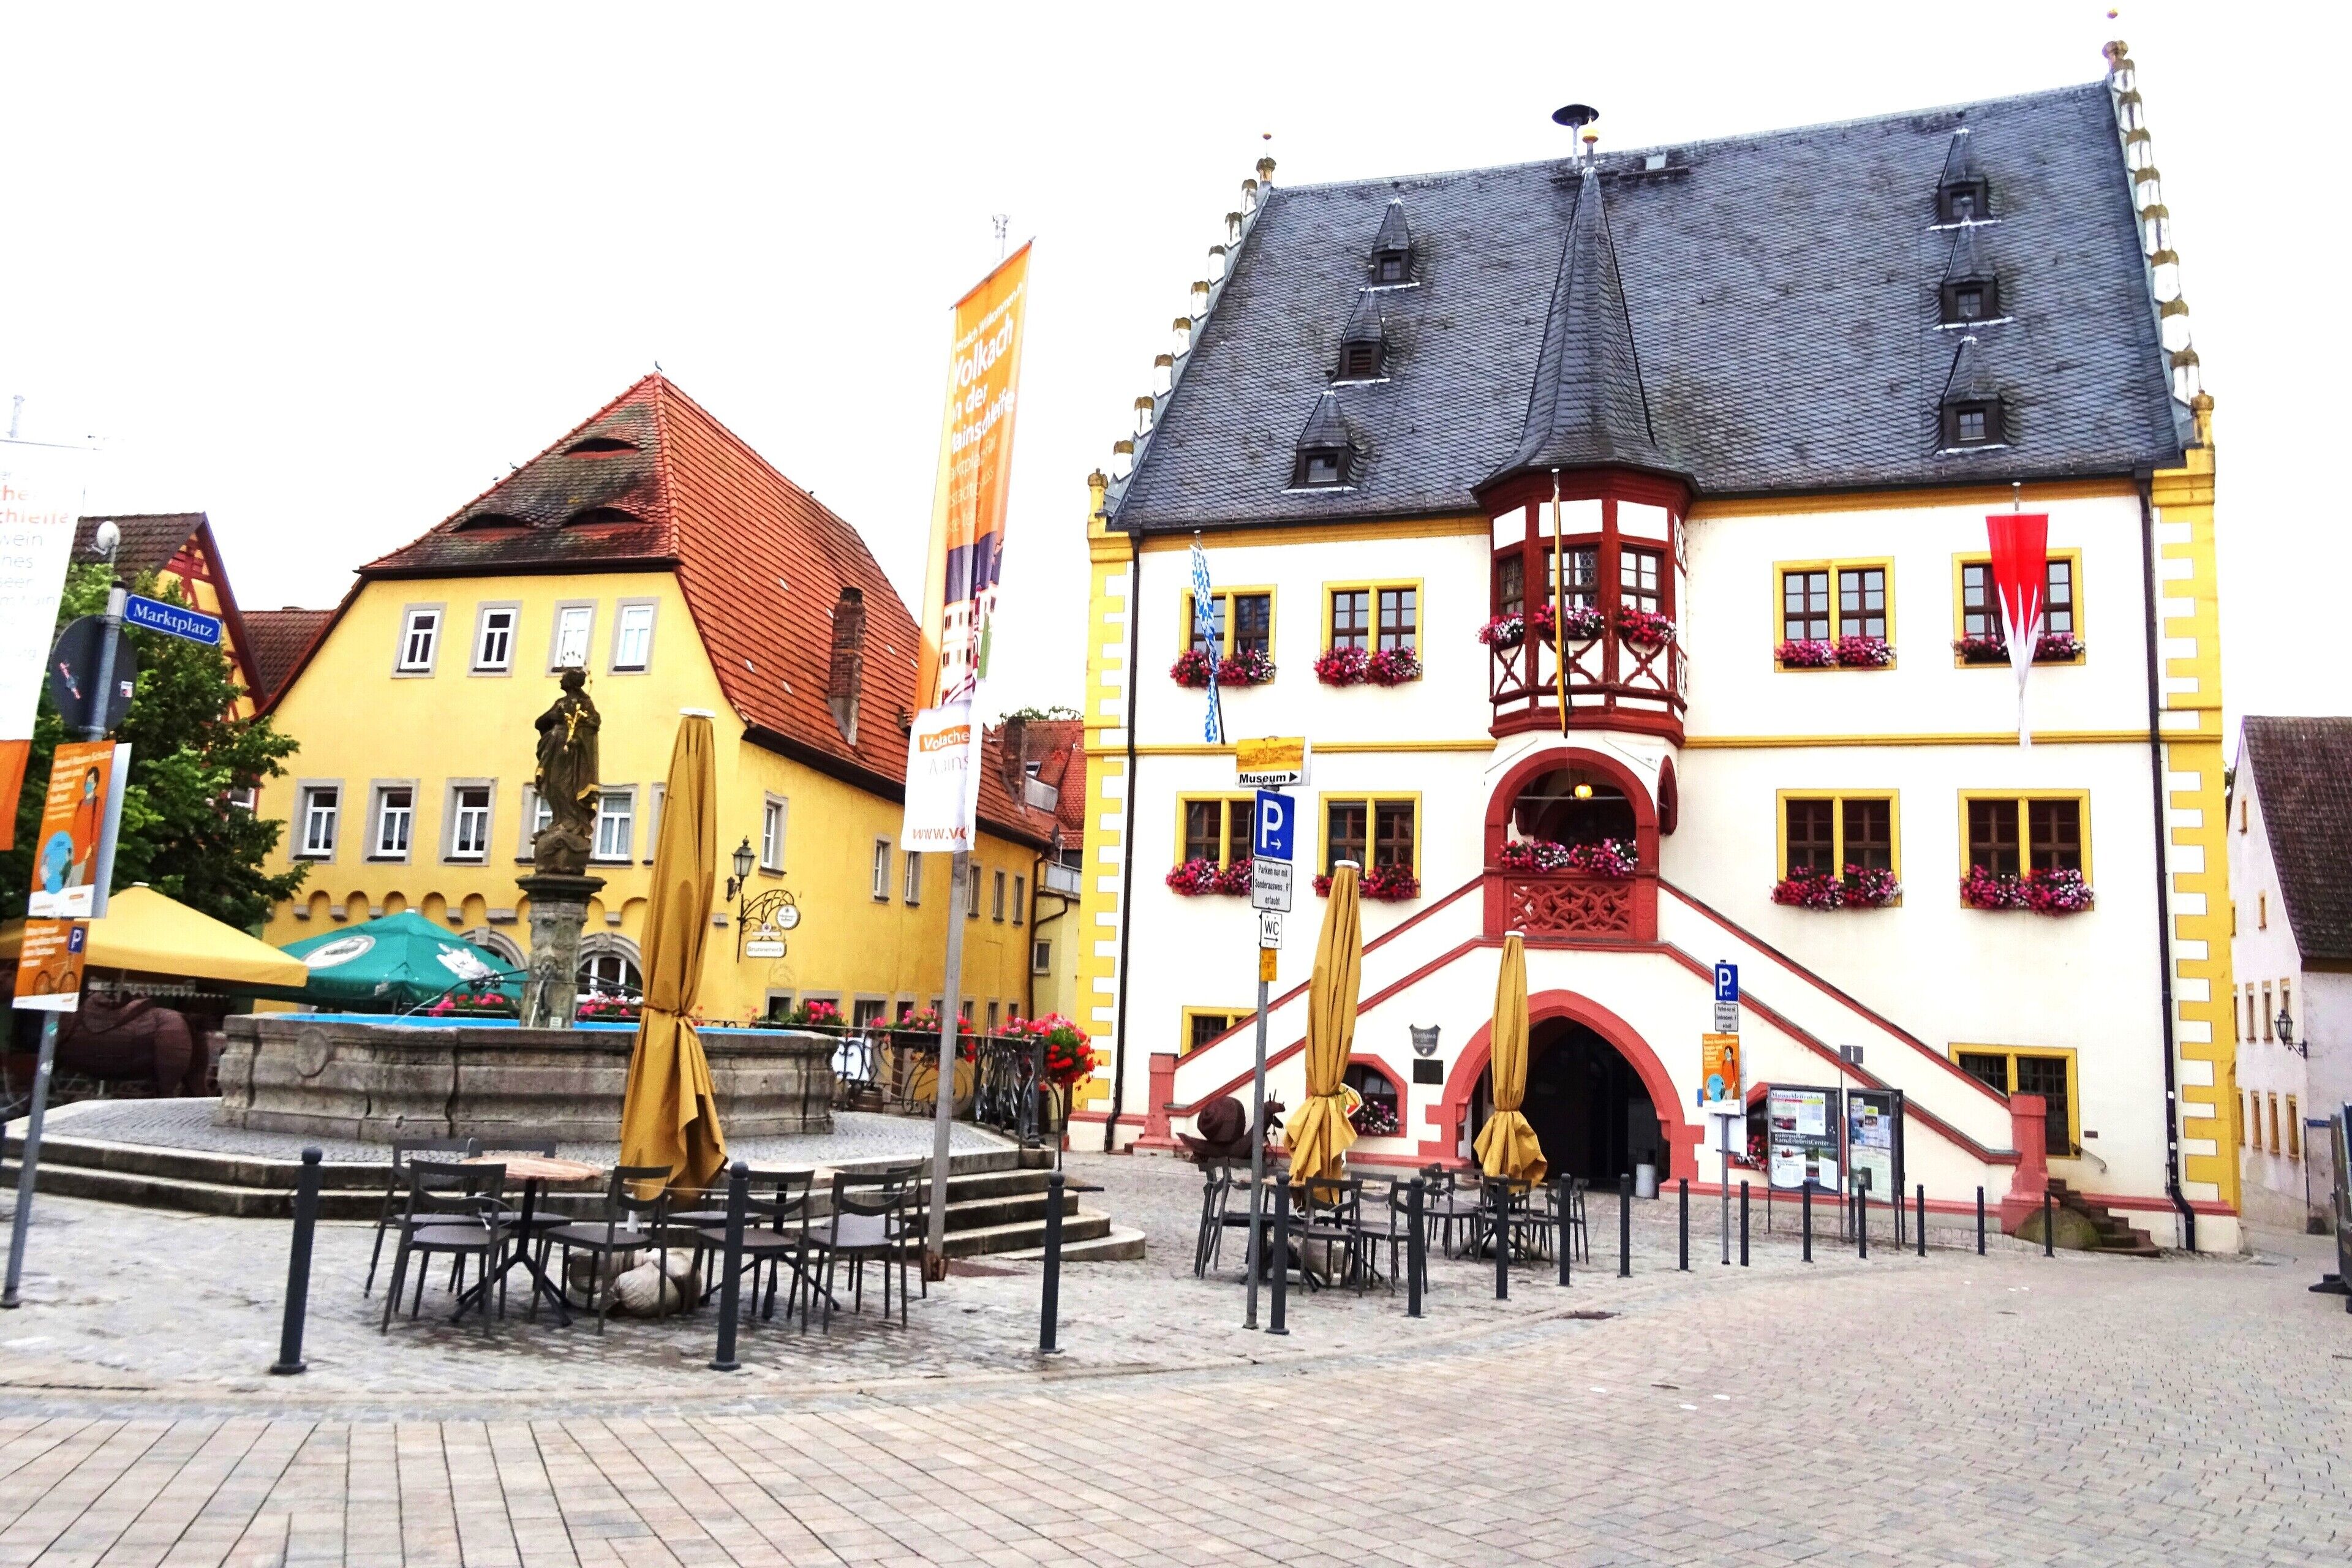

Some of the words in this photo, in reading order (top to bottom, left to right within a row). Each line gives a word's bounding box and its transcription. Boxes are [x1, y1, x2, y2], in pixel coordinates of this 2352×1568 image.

[134, 603, 213, 638] Marktplatz
[1239, 773, 1286, 783] Museum
[1262, 799, 1283, 849] P
[1258, 864, 1273, 875] Parken
[1255, 878, 1283, 891] Sonderausweis
[1265, 895, 1280, 906] erlaubt
[1265, 919, 1280, 935] WC
[1718, 968, 1732, 997] P
